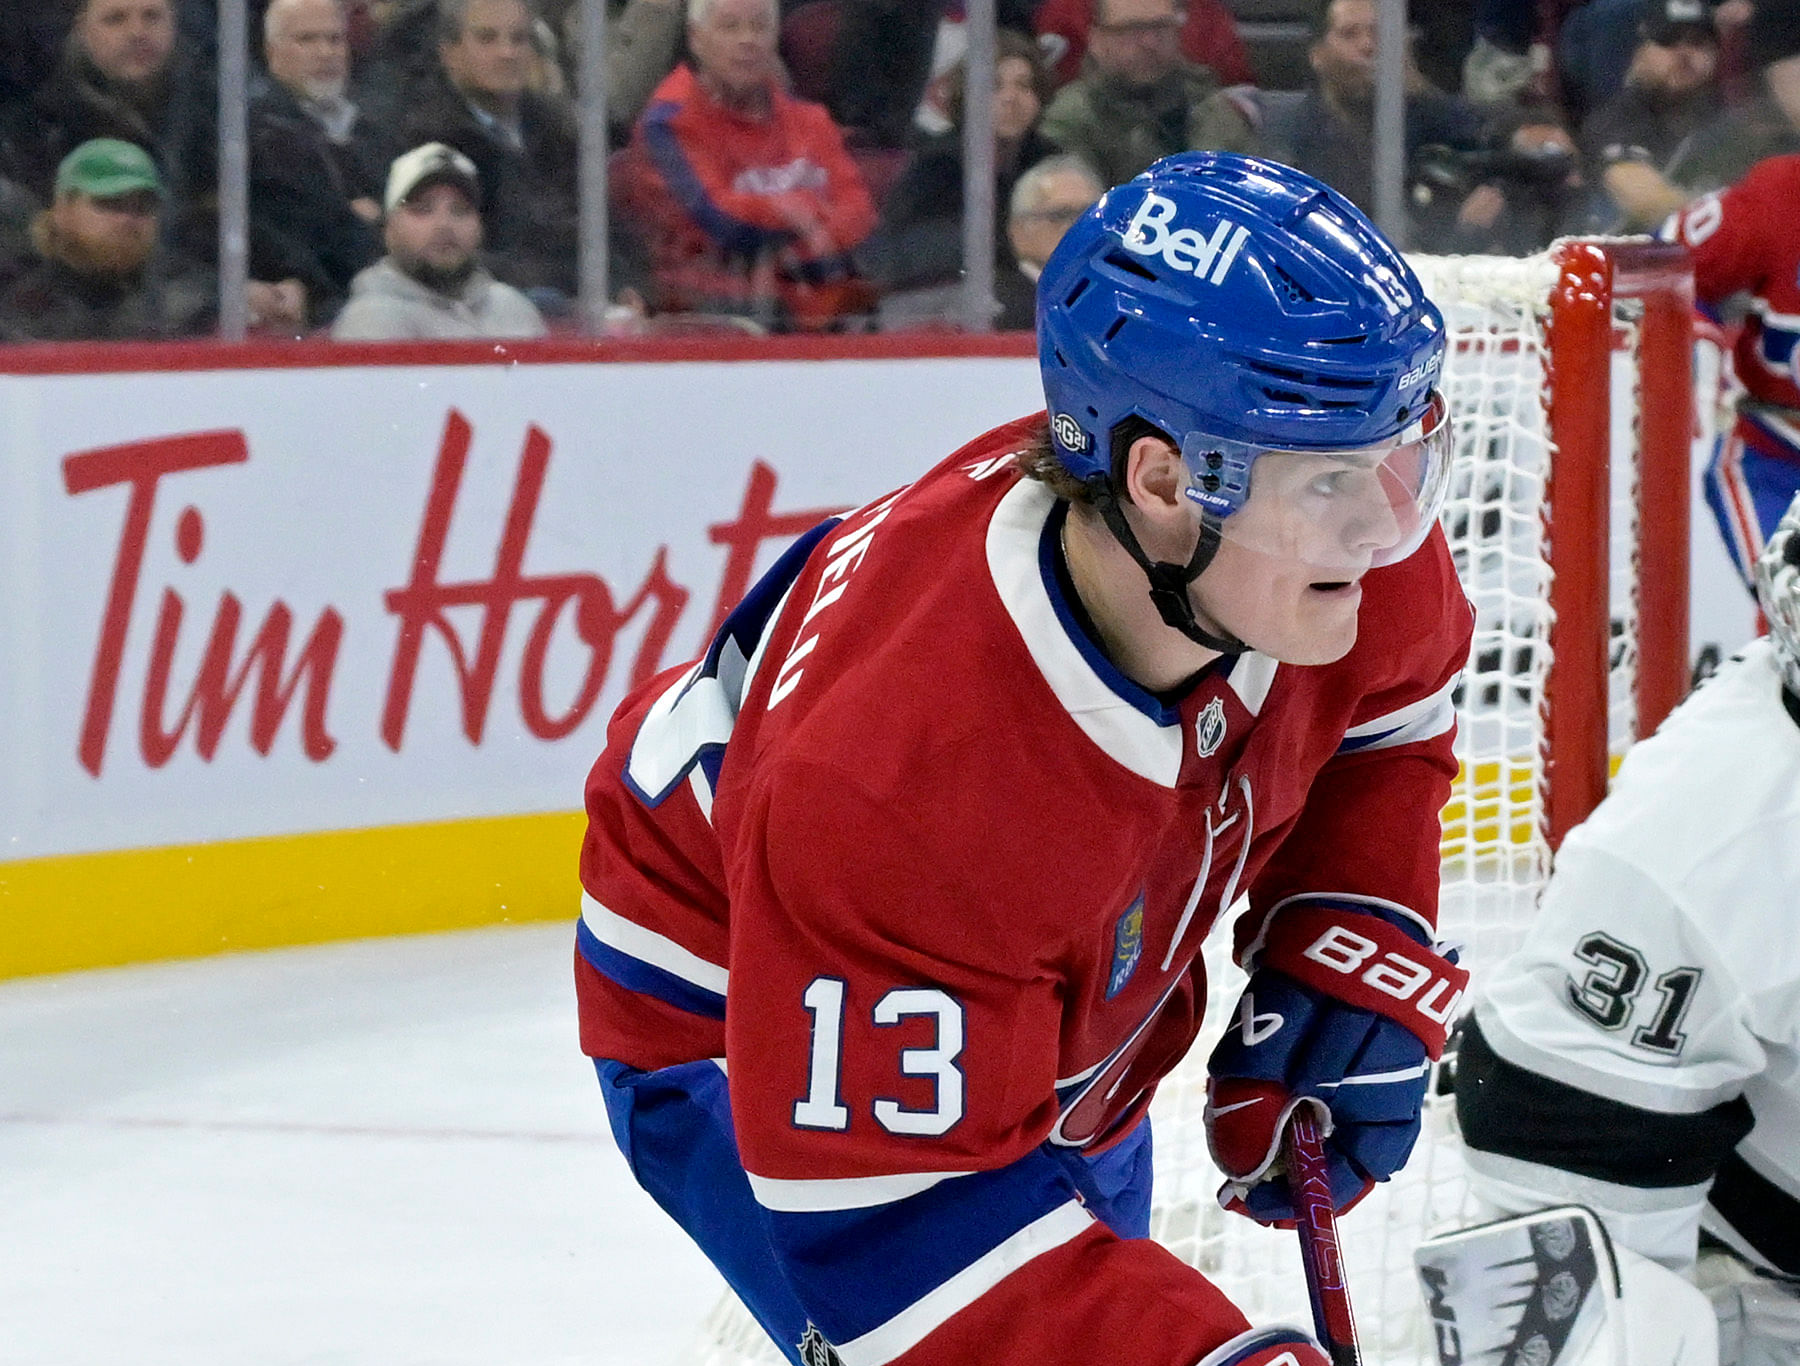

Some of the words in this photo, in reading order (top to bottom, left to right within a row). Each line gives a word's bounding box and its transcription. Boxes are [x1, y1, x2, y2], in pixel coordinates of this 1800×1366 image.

[1123, 192, 1251, 287] Bell
[1363, 263, 1413, 317] 13
[61, 427, 343, 779] Tim
[1566, 930, 1704, 1056] 31
[792, 975, 967, 1138] 13
